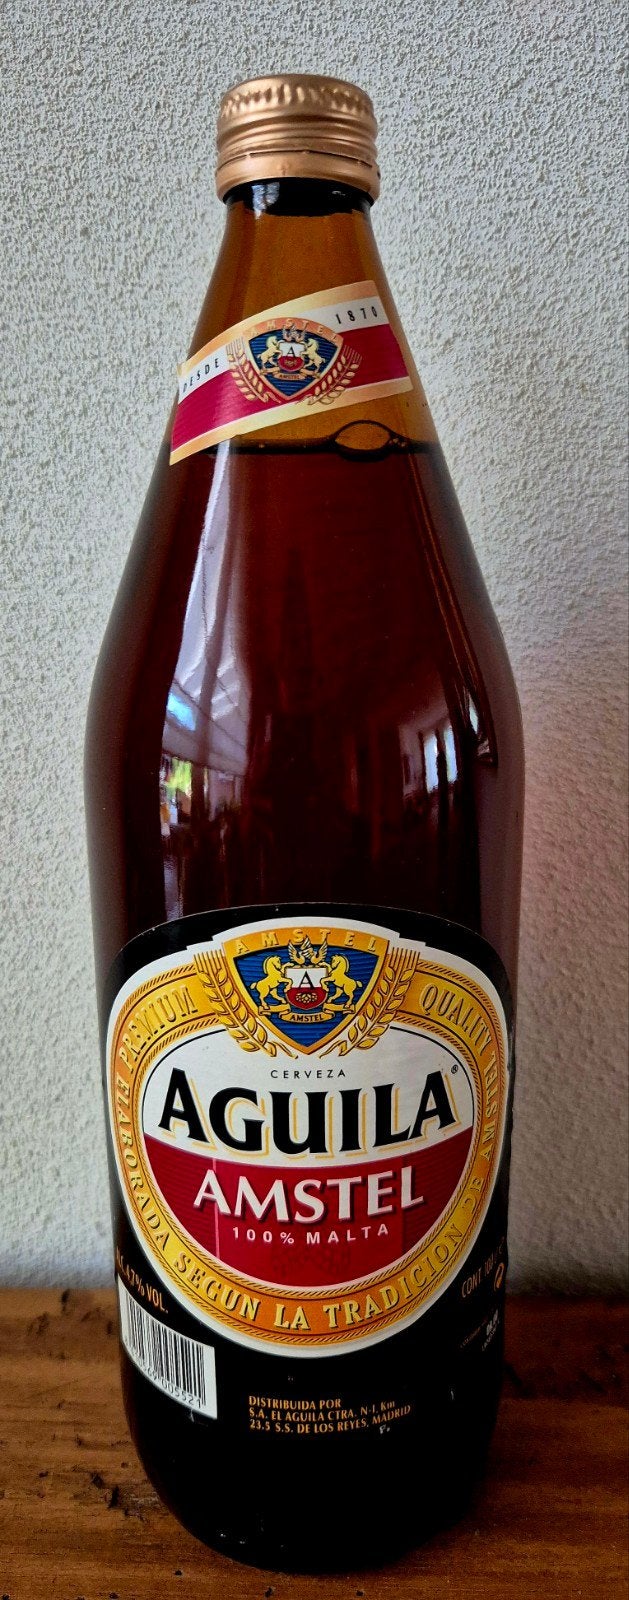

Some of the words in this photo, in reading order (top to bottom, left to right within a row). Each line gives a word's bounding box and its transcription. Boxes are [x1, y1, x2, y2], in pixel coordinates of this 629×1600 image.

[336, 306, 378, 325] 1870
[250, 318, 338, 341] AMSTEL
[287, 346, 296, 357] A
[182, 357, 220, 393] DESDE
[235, 928, 377, 954] AMSTEL
[299, 970, 315, 989] A
[119, 984, 198, 1074] PREMIUM
[290, 1013, 323, 1022] AMSTEL
[421, 982, 492, 1057] QUALITY
[270, 1068, 346, 1079] CERVEZA
[158, 1067, 461, 1156] AGUILA
[115, 1072, 170, 1251] ELABORADA
[174, 1250, 261, 1322] SEGUN
[274, 1303, 311, 1331] LA
[323, 1223, 464, 1329] TRADICION
[478, 1050, 499, 1162] AMSTEL
[193, 1165, 425, 1225] AMSTEL
[232, 1226, 295, 1245] 100%
[306, 1223, 389, 1245] MALTA
[146, 1283, 169, 1314] VOL.
[249, 1396, 316, 1410] DISTRIBUIDA
[319, 1398, 342, 1409] POR
[249, 1407, 268, 1419] S.A.
[271, 1411, 282, 1421] EL
[285, 1411, 325, 1422] AGUILA
[327, 1408, 358, 1421] CTRA.
[380, 1401, 396, 1412] Km
[275, 1422, 294, 1433] S.S.
[297, 1423, 311, 1434] DE
[314, 1422, 334, 1434] LOS
[372, 1404, 411, 1425] MADRID
